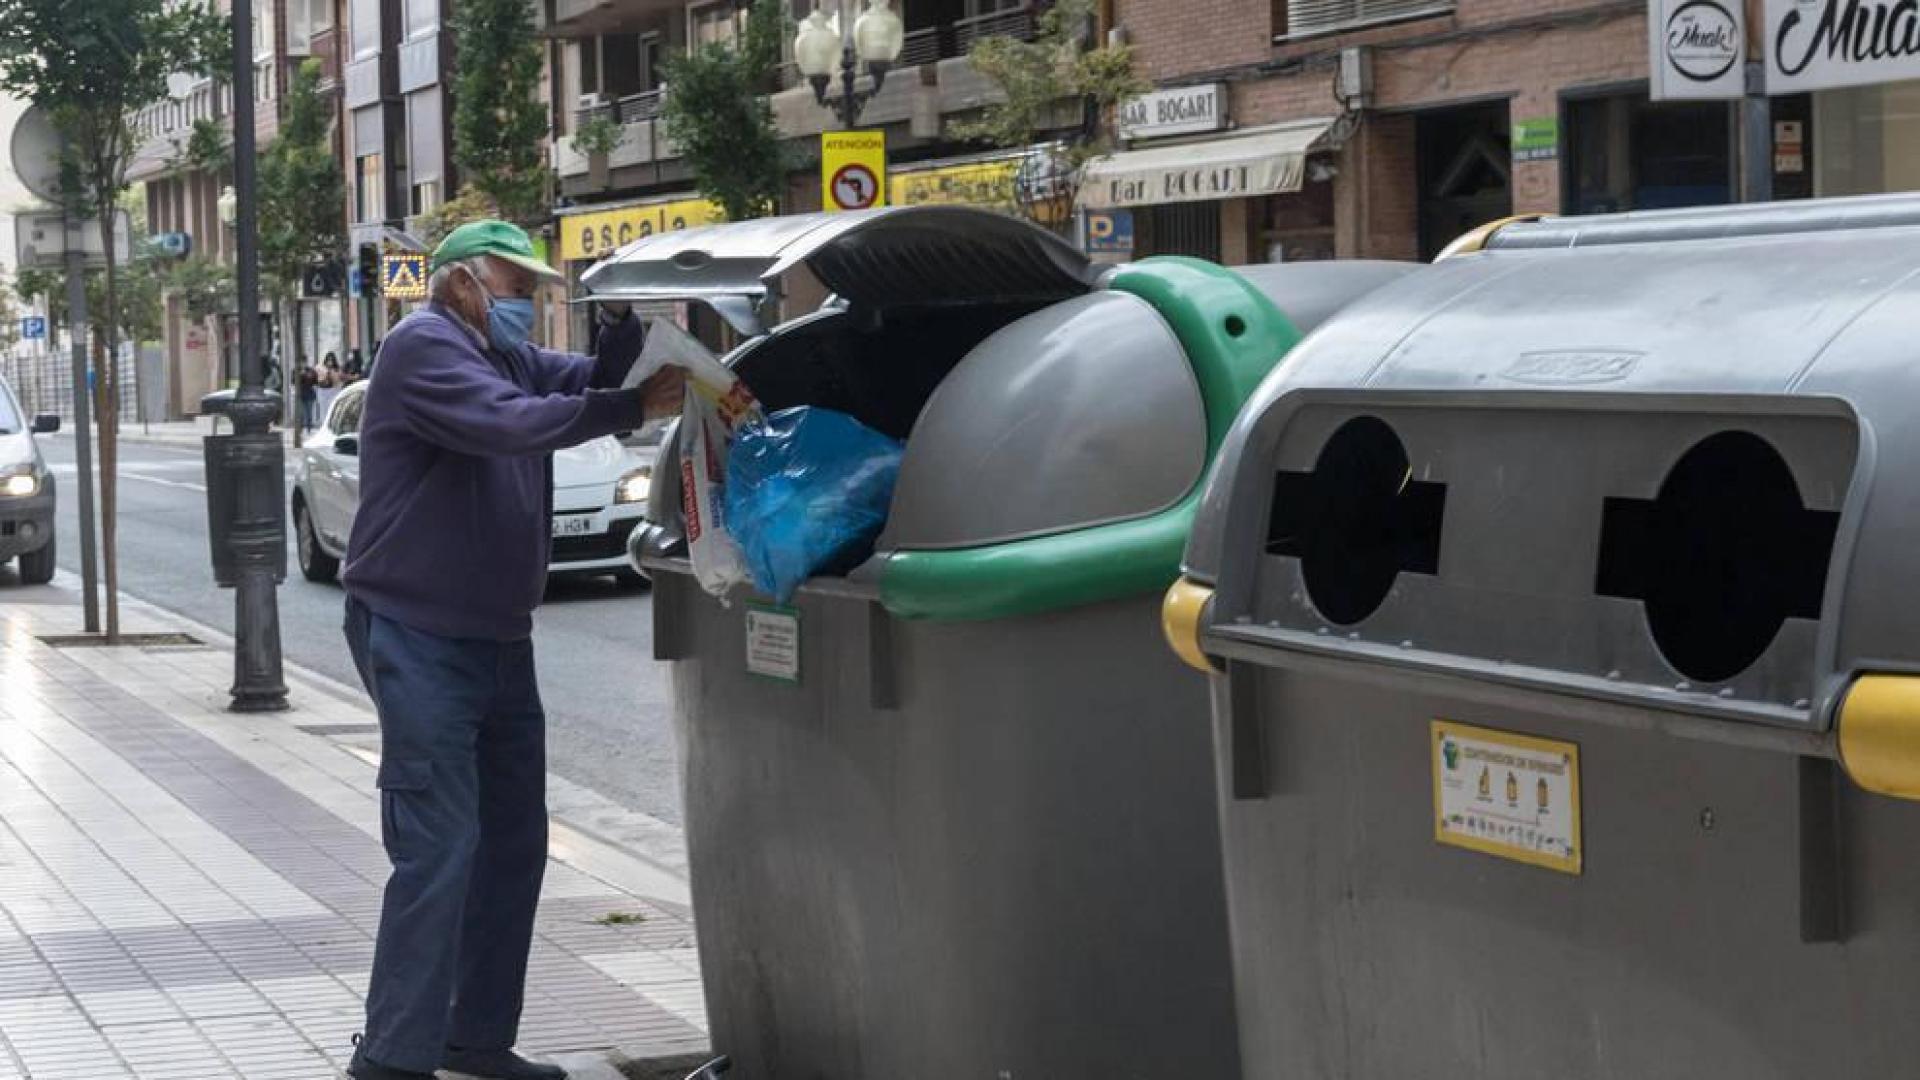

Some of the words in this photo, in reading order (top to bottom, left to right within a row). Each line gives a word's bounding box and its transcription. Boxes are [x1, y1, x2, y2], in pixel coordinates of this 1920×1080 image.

[1120, 102, 1147, 126] BAR
[1157, 92, 1213, 123] BOGART
[825, 137, 882, 151] ATENCIÓN
